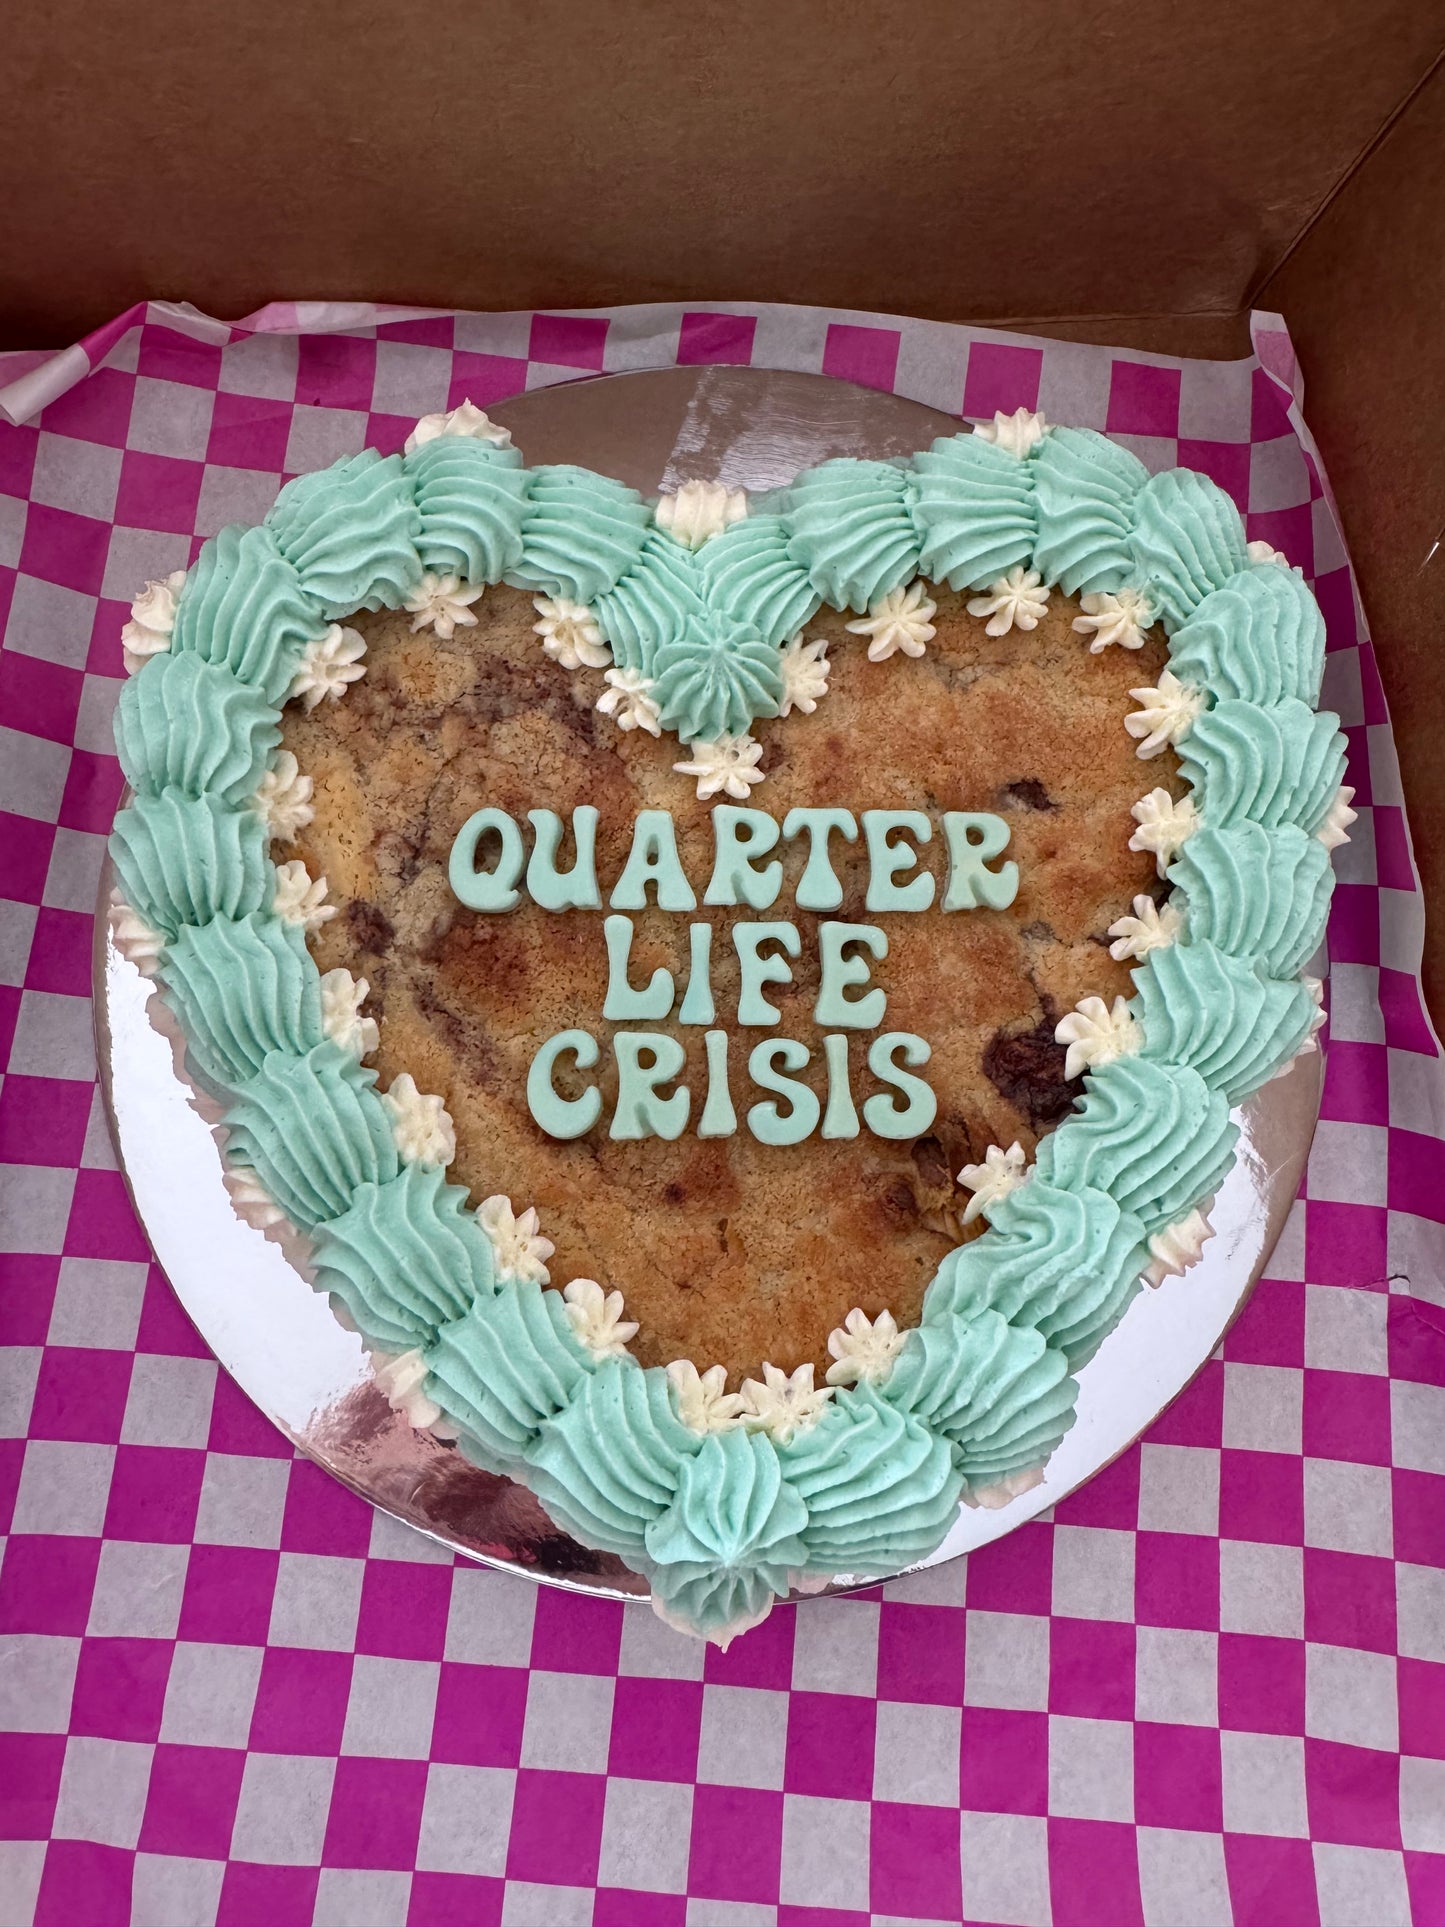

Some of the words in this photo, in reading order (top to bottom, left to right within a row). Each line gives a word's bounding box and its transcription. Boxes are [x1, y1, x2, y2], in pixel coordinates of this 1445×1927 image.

[448, 804, 1019, 913] QUARTER
[602, 914, 888, 1029] LIFE
[526, 1028, 937, 1146] CRISIS
